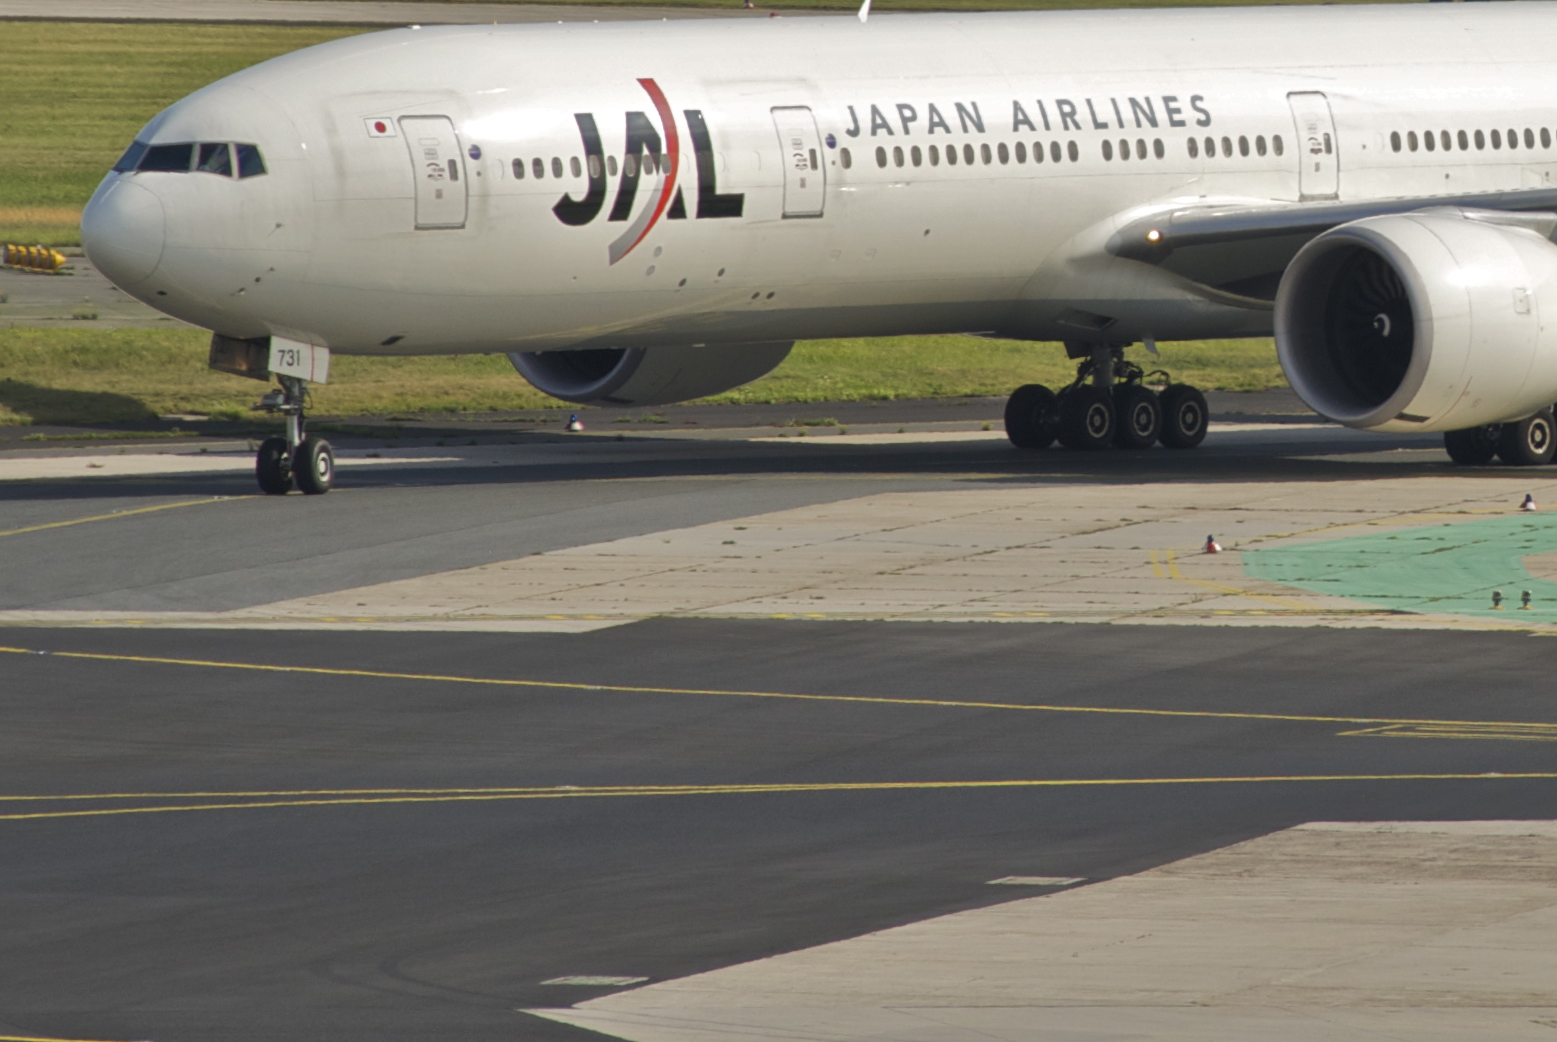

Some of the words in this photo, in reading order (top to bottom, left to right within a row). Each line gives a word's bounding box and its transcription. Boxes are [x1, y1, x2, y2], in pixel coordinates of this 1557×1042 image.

[845, 101, 986, 138] JAPAN
[1012, 94, 1212, 132] AIRLINES
[552, 109, 745, 227] JAL
[277, 349, 300, 367] 731
